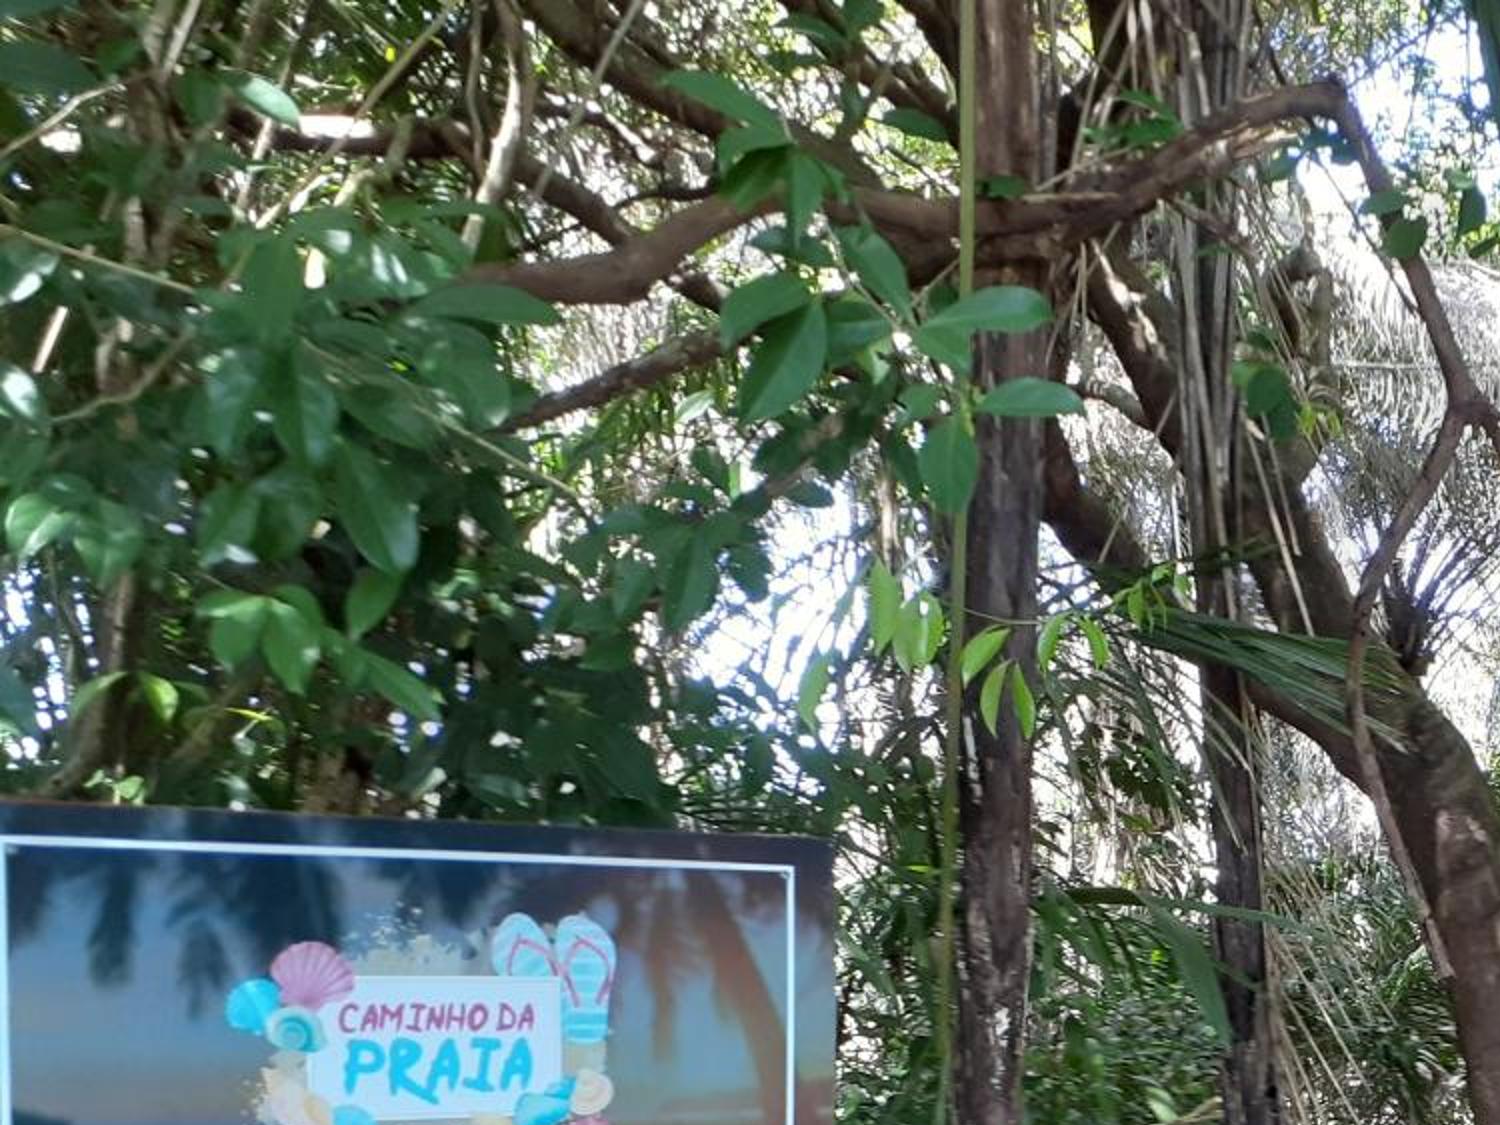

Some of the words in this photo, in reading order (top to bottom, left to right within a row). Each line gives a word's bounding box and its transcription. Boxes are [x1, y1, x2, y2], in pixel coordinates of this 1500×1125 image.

[338, 1002, 489, 1034] CAMINHO
[495, 1003, 536, 1031] DA
[342, 1036, 534, 1105] PRAIA
